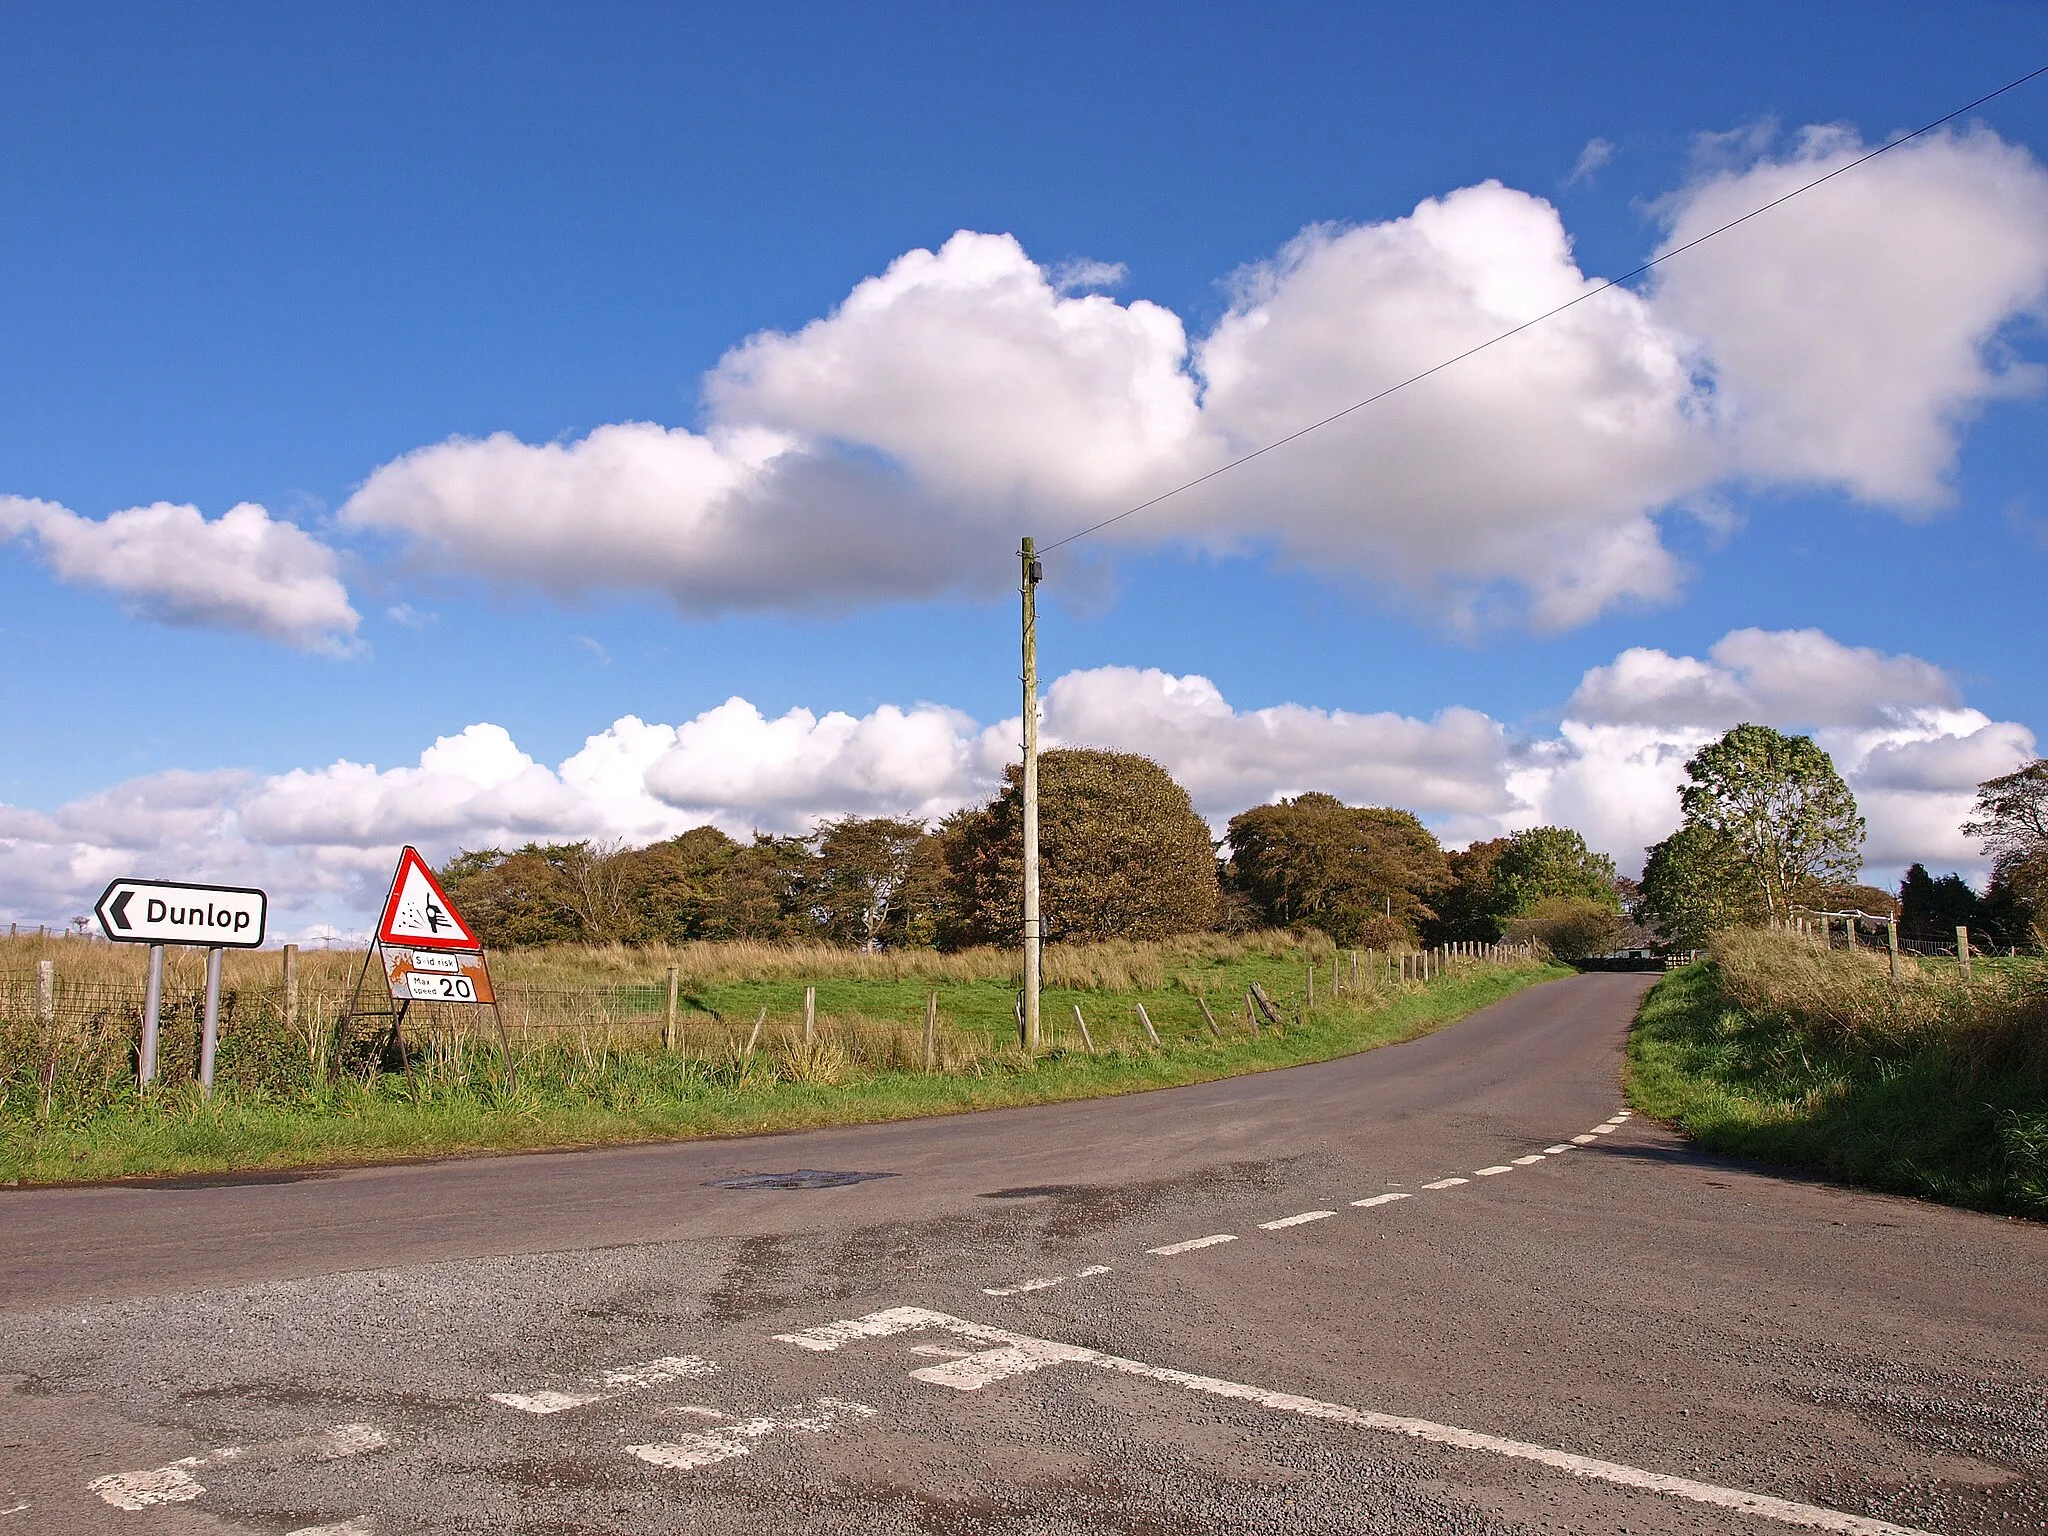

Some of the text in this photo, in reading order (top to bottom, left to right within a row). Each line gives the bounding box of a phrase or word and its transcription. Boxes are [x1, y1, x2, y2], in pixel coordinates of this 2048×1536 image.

[147, 899, 250, 932] Dunlop
[415, 956, 454, 967] Sid risk
[413, 977, 430, 985] Max
[440, 979, 470, 998] 20
